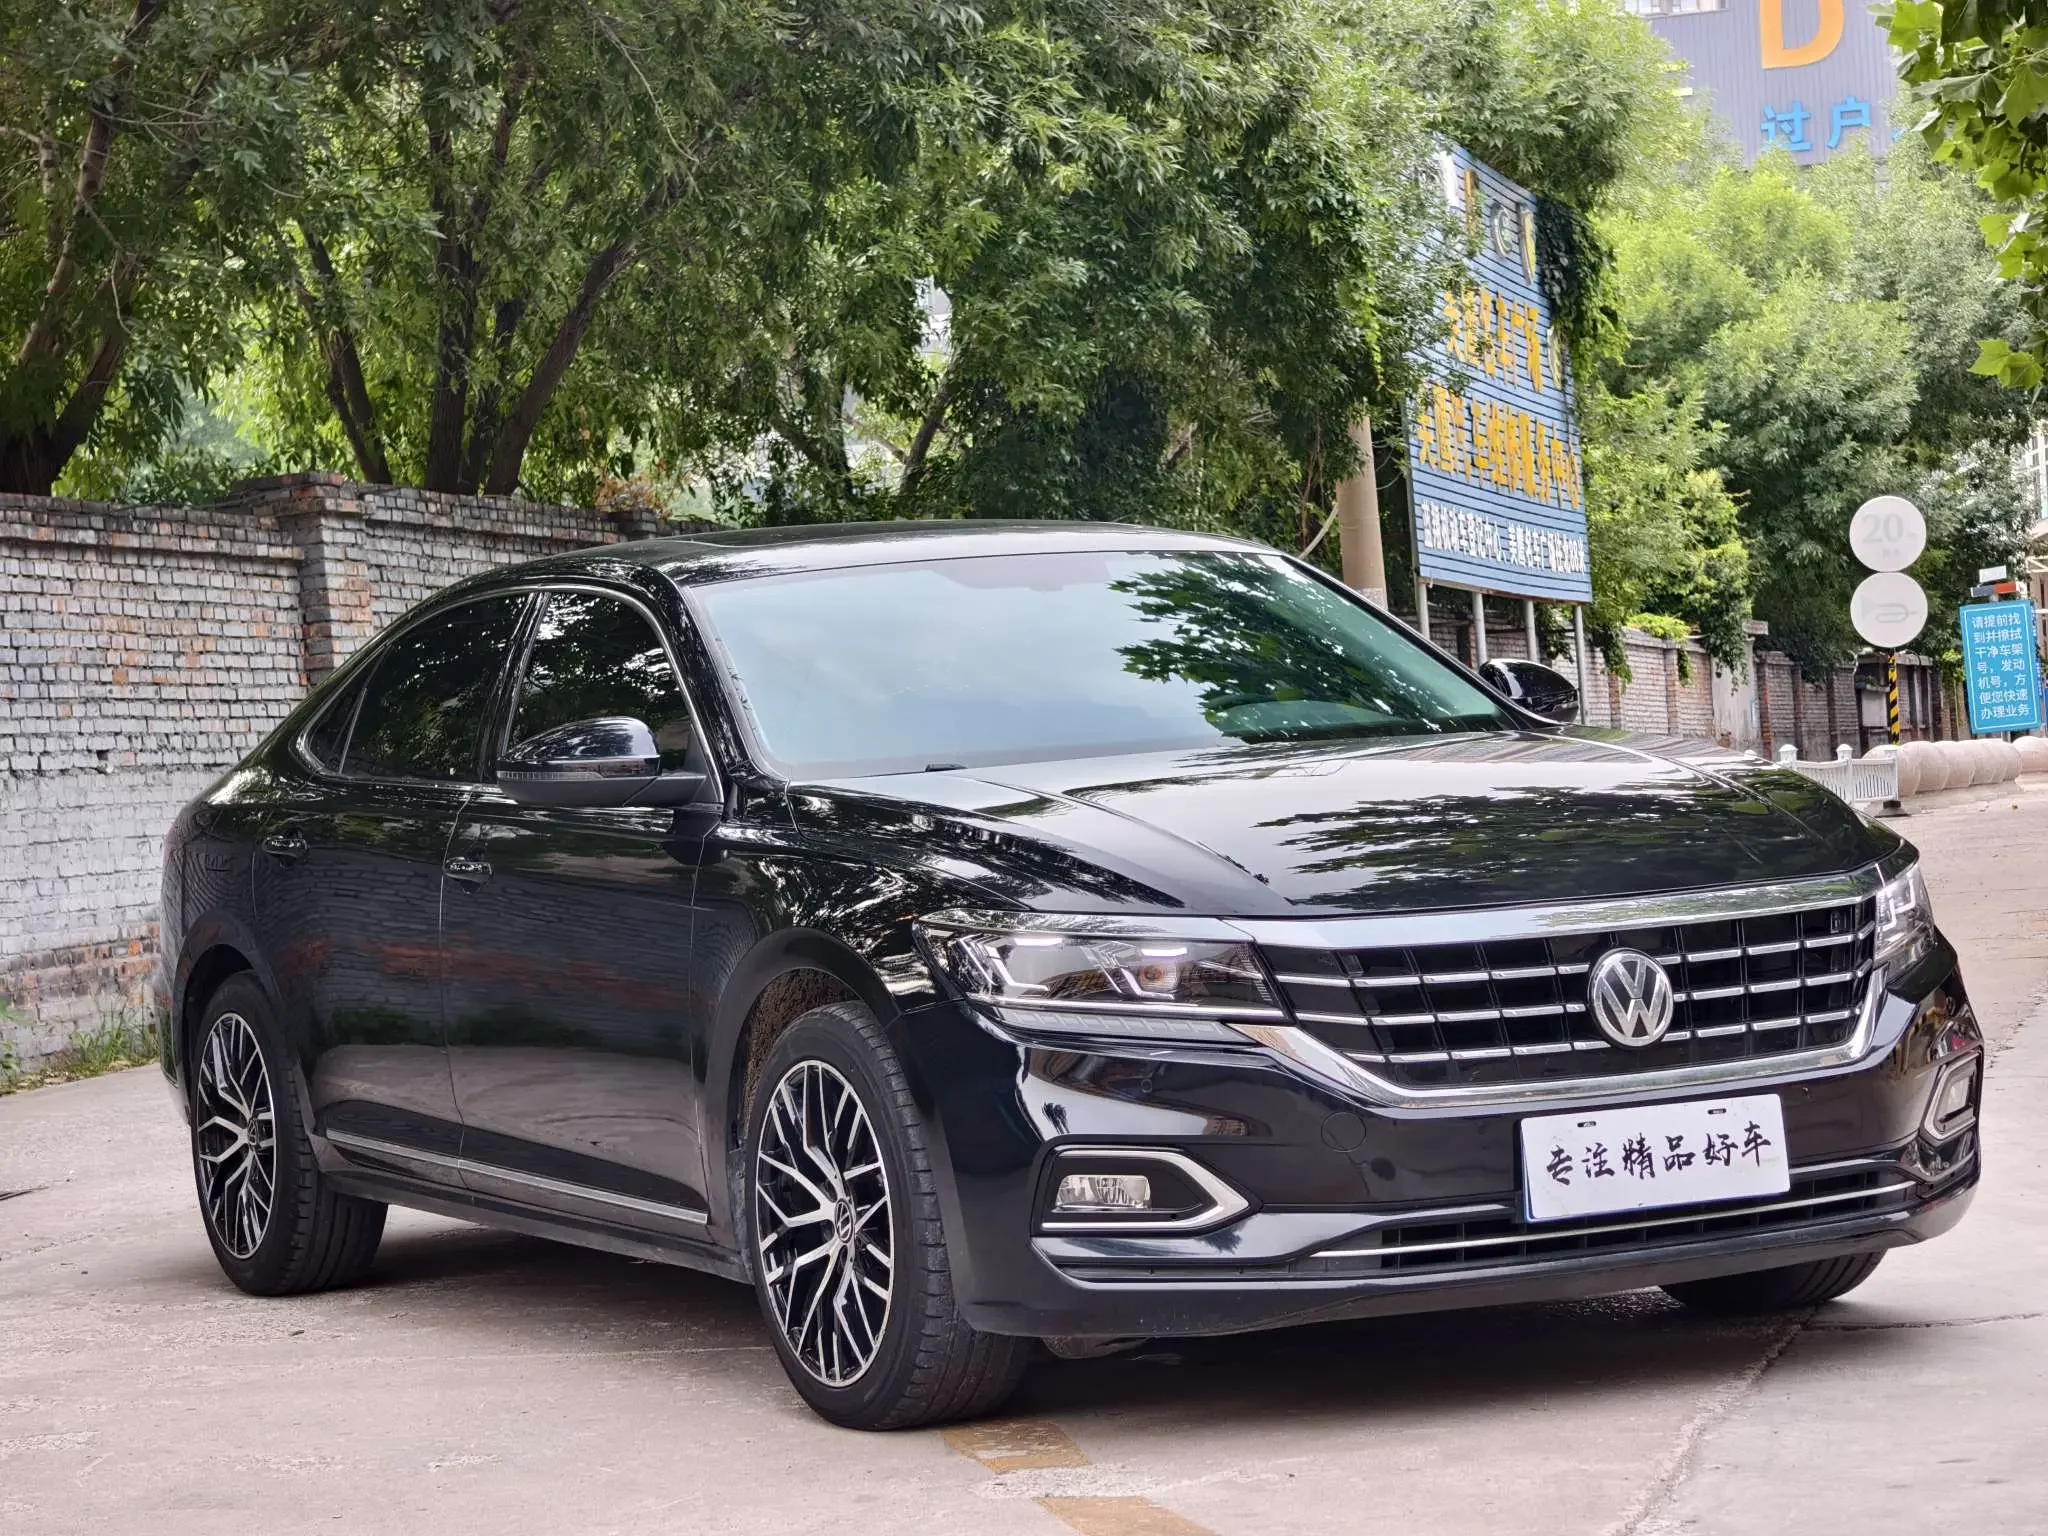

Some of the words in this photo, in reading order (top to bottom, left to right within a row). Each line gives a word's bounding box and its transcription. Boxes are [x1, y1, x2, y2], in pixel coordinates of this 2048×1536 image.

[1760, 95, 1902, 152] 过户
[1861, 513, 1903, 543] 20
[1972, 612, 2020, 629] 请提前找
[1973, 627, 2022, 644] 到并擦拭
[1975, 643, 2023, 659] 干净车架
[1980, 689, 2028, 705] 便您快速
[1981, 704, 2029, 720] 办理业务
[1546, 1120, 1771, 1186] 专注精品好车
